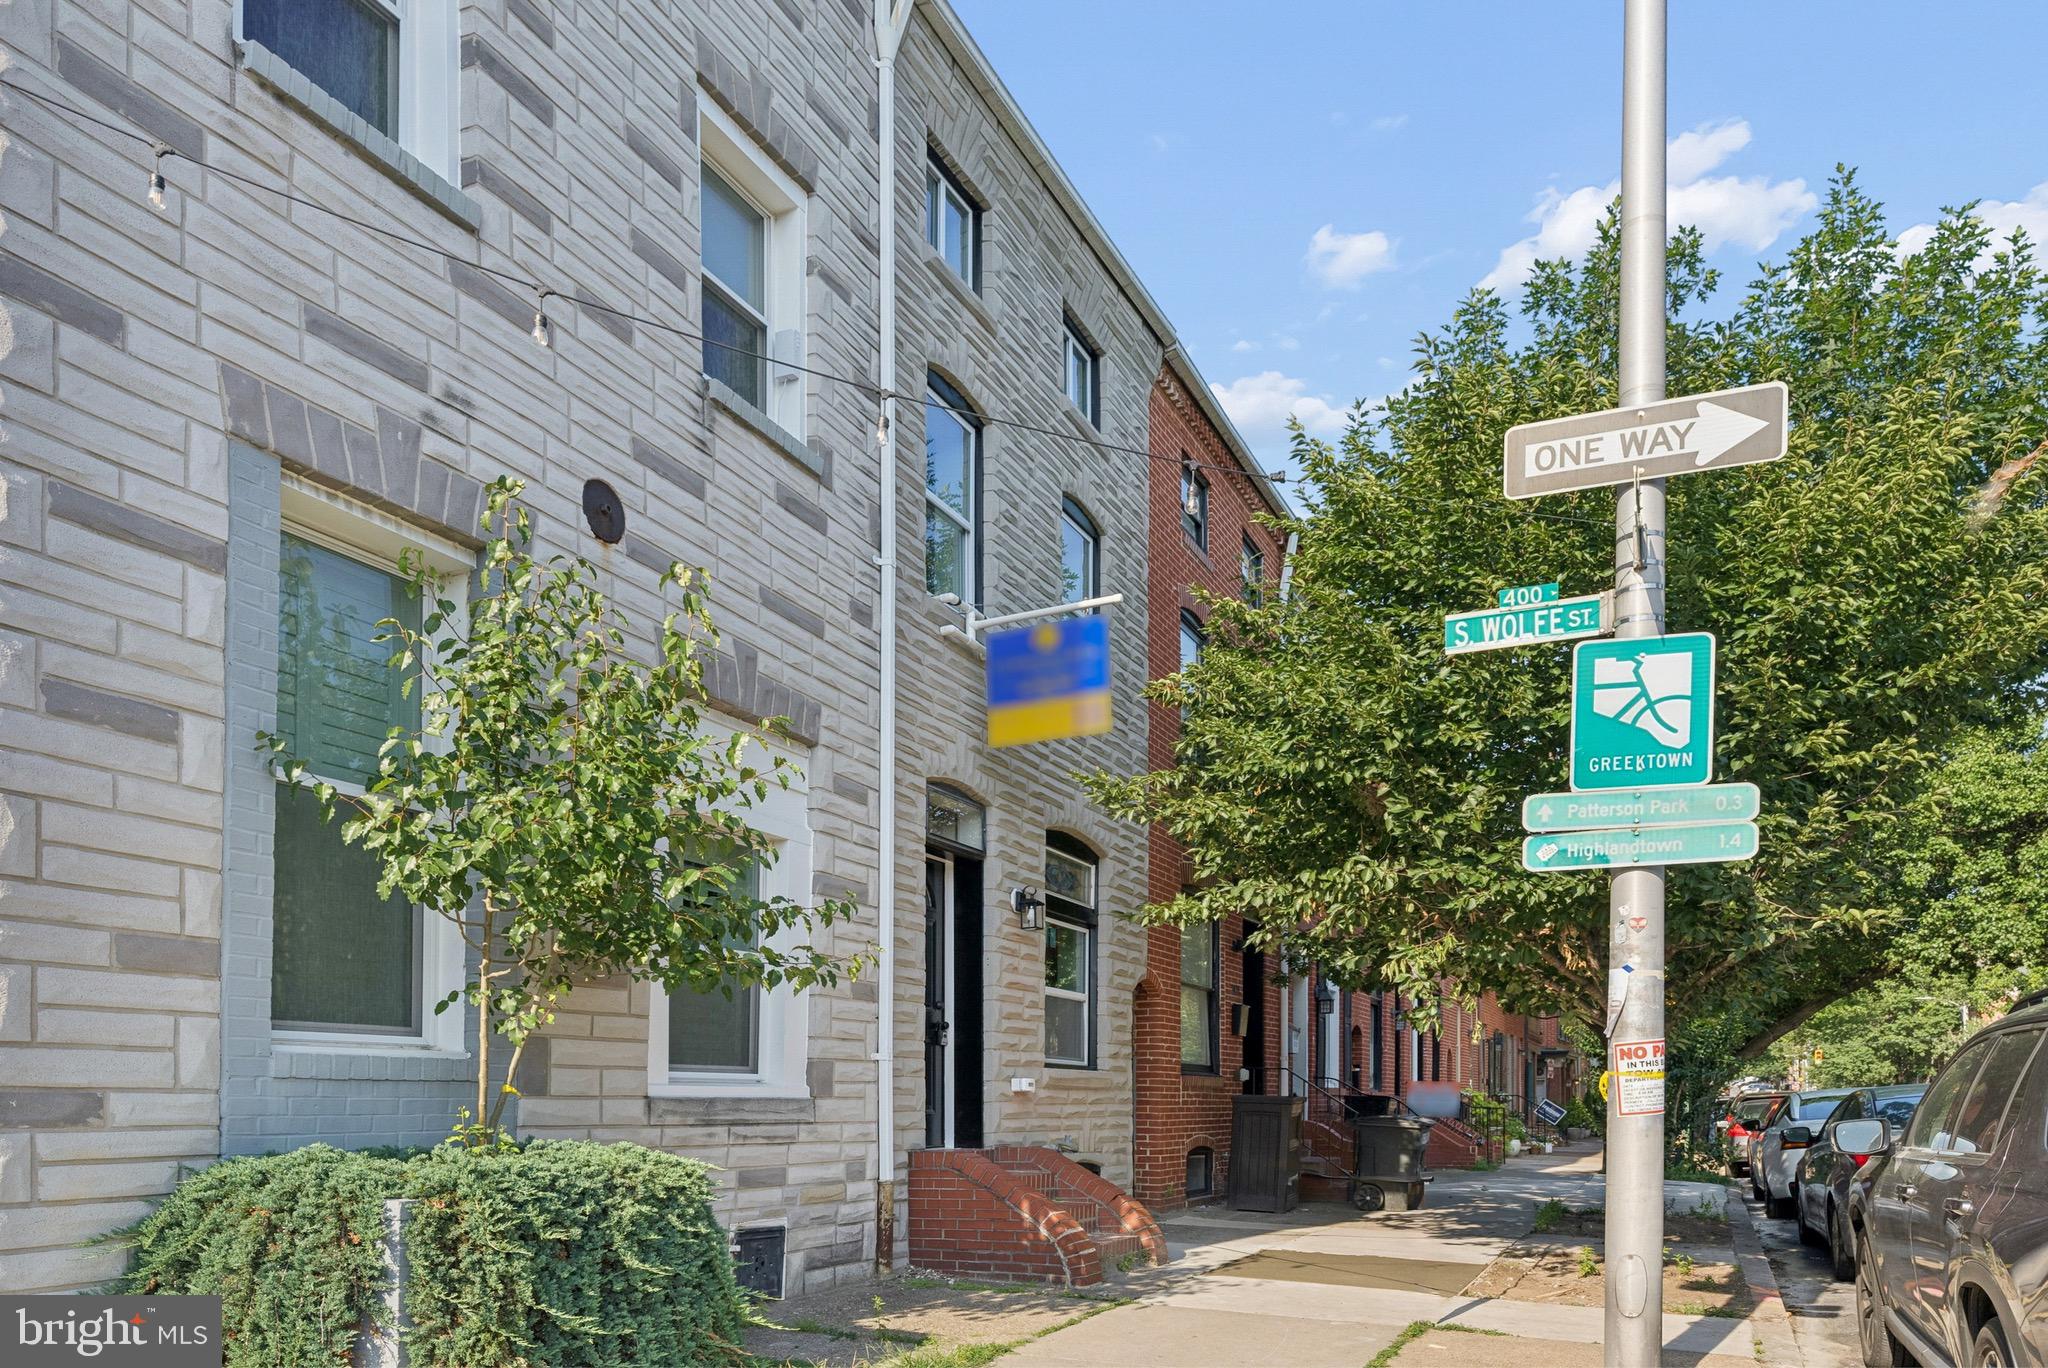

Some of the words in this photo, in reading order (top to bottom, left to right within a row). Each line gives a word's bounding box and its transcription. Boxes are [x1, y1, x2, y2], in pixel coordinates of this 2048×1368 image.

[1534, 437, 1604, 472] ONE
[1619, 421, 1697, 458] WAY
[1503, 586, 1542, 606] 400
[1454, 620, 1474, 647] S.
[1482, 608, 1564, 643] WOLFE
[1568, 608, 1595, 627] ST.
[1589, 752, 1693, 772] GREEKTOWN
[1567, 803, 1644, 818] Patterson
[1650, 800, 1689, 814] Park
[1715, 794, 1743, 811] 0.3
[1567, 840, 1683, 861] Highlandtown
[1719, 833, 1742, 849] 1.4
[1619, 1046, 1648, 1060] NO
[1627, 1061, 1637, 1069] IN
[1639, 1060, 1659, 1068] THIS
